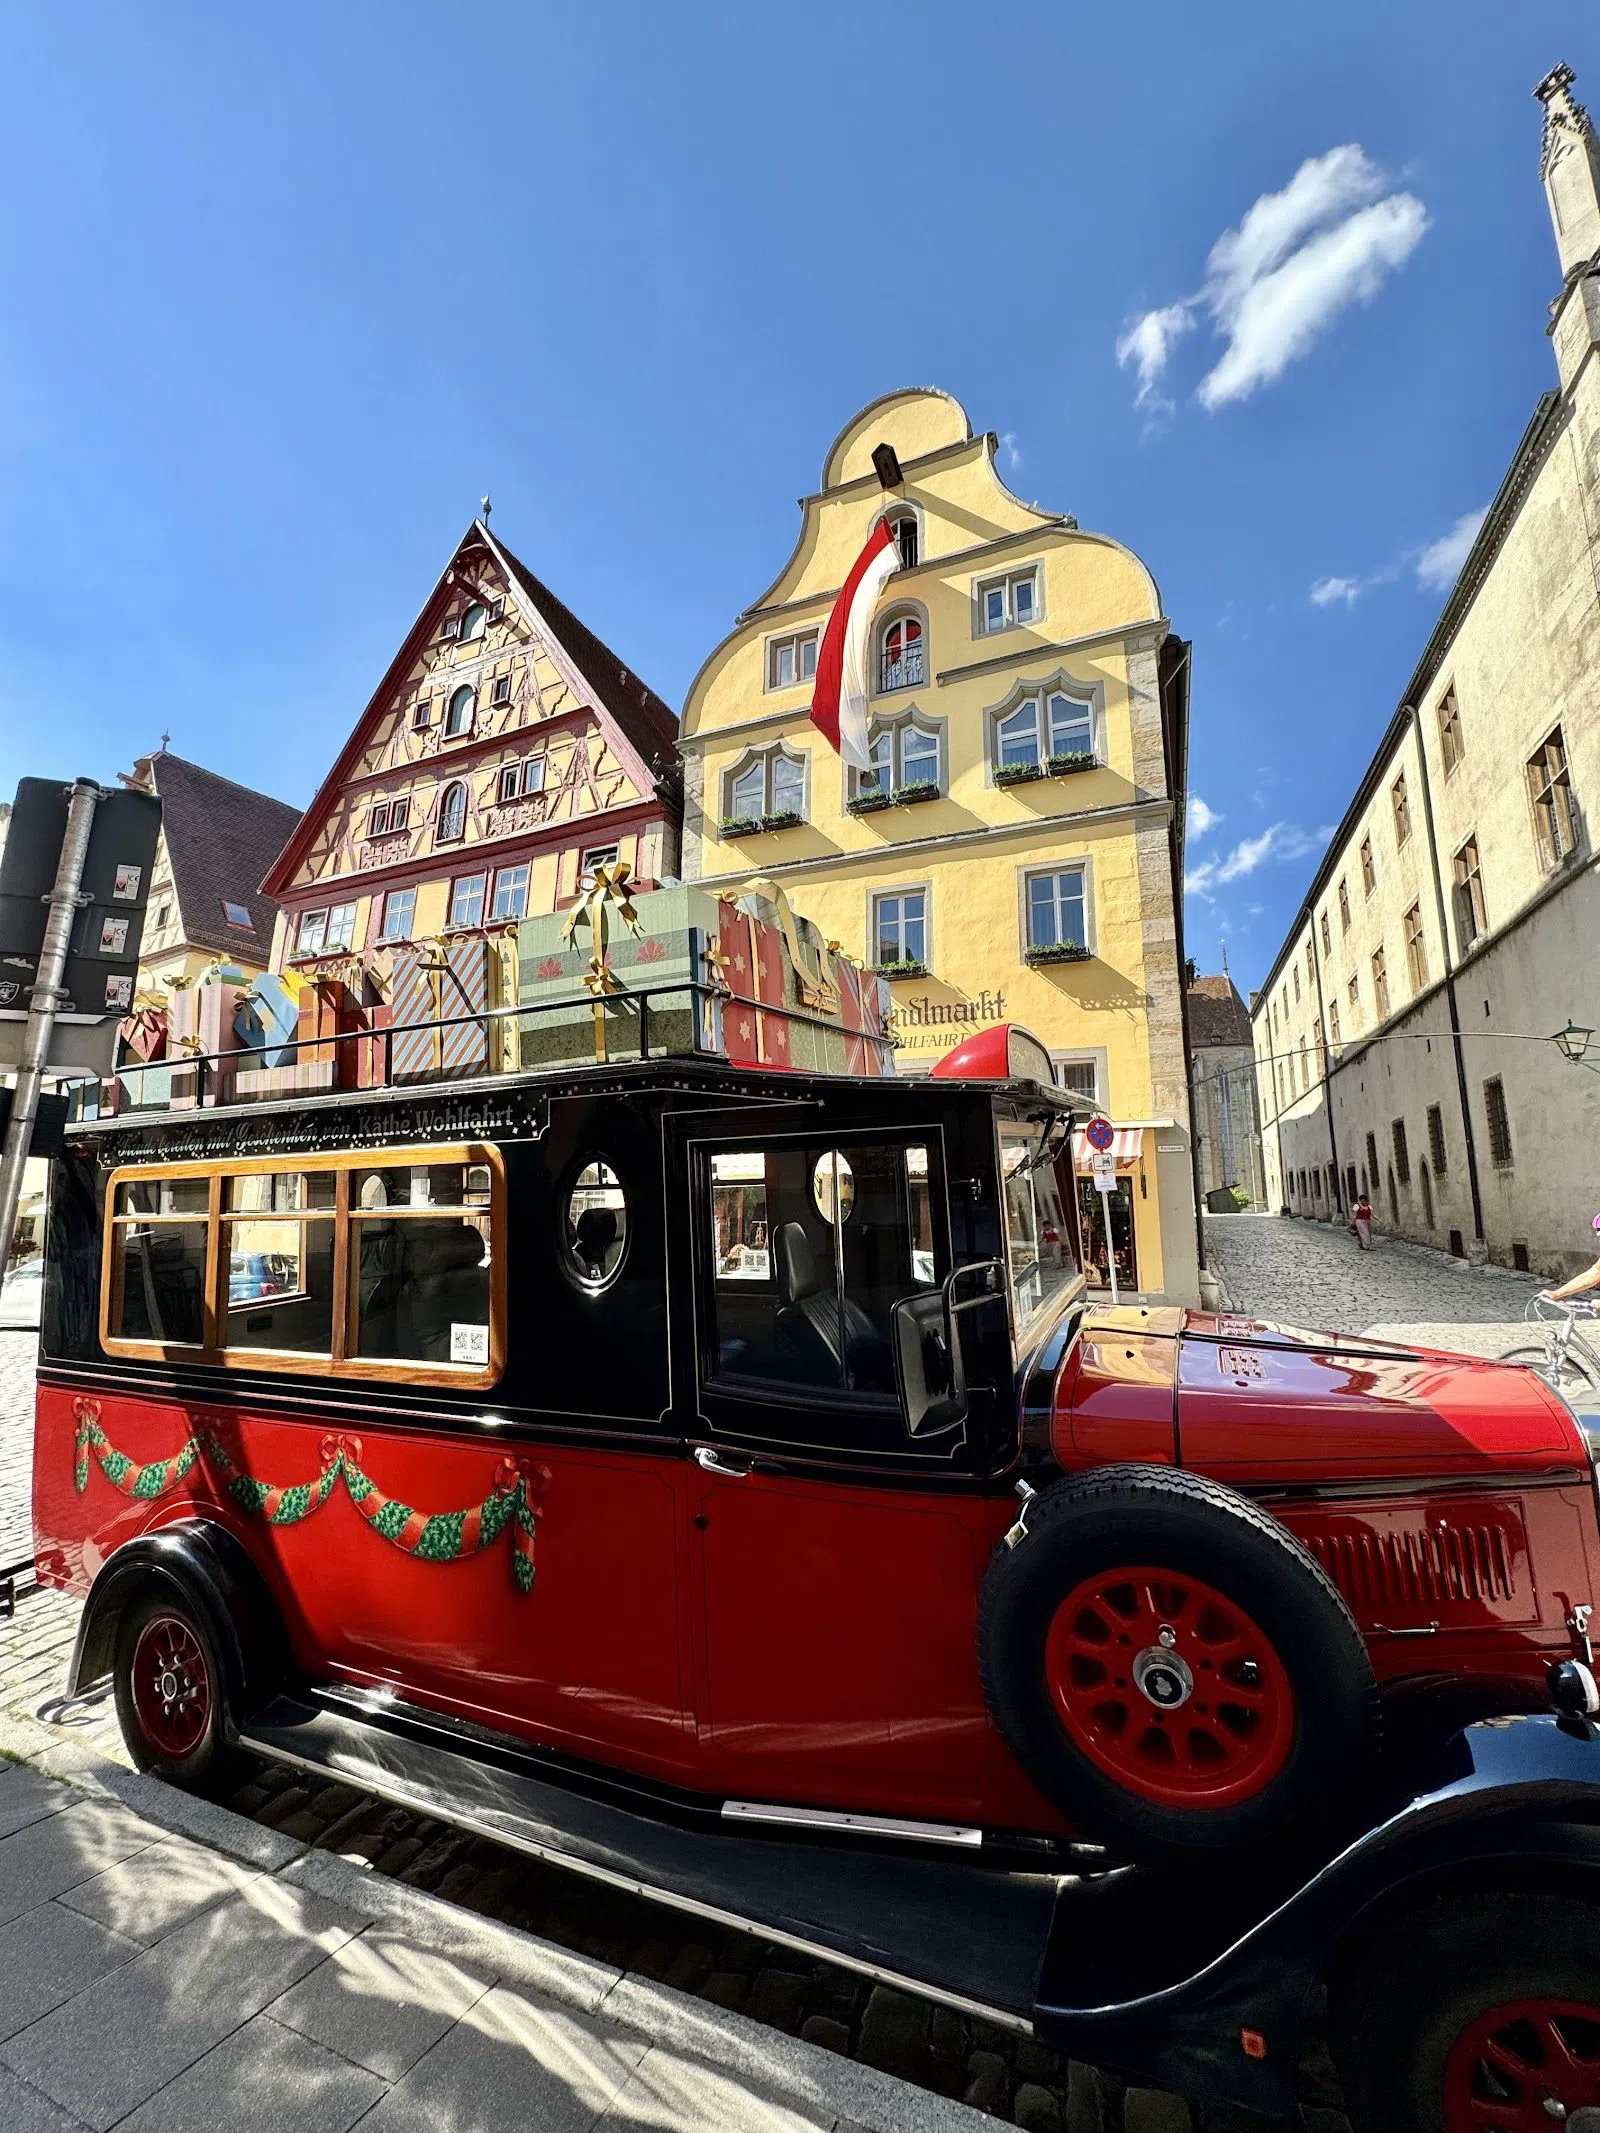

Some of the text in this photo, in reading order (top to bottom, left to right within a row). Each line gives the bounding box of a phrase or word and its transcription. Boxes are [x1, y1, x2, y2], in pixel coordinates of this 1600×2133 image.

[893, 989, 1007, 1028] ndlmarkt
[903, 1032, 969, 1049] HLFAHRT
[157, 1132, 204, 1154] bereiten
[206, 1128, 234, 1150] mit
[236, 1121, 318, 1150] Geschenken
[321, 1123, 350, 1140] von
[358, 1112, 411, 1138] Käthe
[416, 1104, 514, 1132] Wohlfahrt
